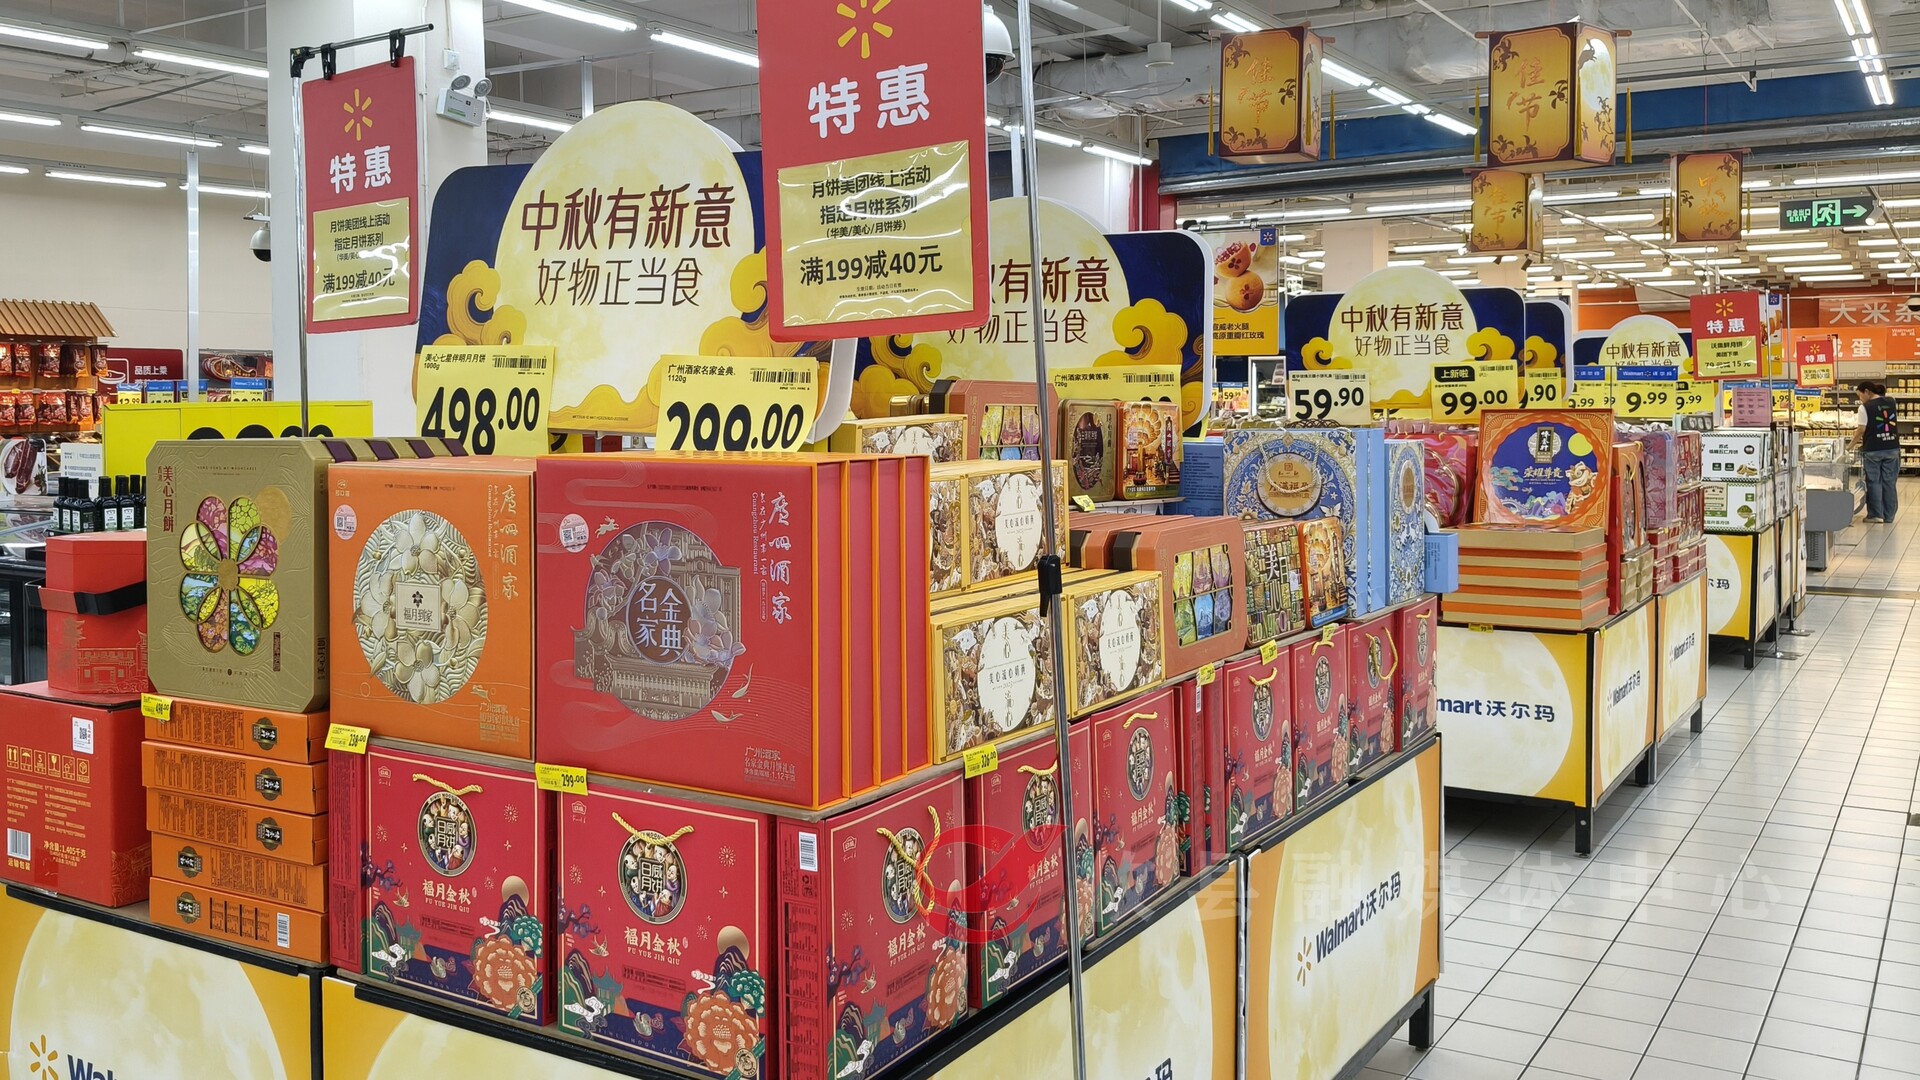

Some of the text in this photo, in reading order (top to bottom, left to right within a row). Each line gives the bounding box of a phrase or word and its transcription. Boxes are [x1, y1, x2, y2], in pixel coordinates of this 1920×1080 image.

[807, 62, 930, 139] 特惠
[1242, 57, 1276, 124] 佳节
[1510, 56, 1546, 130] 佳节
[330, 145, 391, 193] 特惠
[811, 164, 931, 199] 月饼美团线上活动
[521, 183, 735, 251] 中秋有新意
[820, 194, 918, 225] 指定月饼系列
[1789, 215, 1808, 223] EXIT
[330, 213, 391, 233] 月饼美团线上活动
[334, 232, 384, 251] 指定月饼系列
[800, 244, 943, 287] 满199减40元
[322, 268, 396, 293] 满199减40元
[534, 257, 703, 306] 好物正当食
[991, 256, 1111, 304] 有新意
[1341, 302, 1464, 334] 中秋有新意
[1706, 318, 1745, 334] 特惠
[1355, 334, 1452, 358] 好物正当食
[1606, 341, 1682, 360] 中秋有新意
[1805, 354, 1826, 363] 特惠
[668, 374, 687, 384] 1120g
[1440, 369, 1469, 379] 上新啦
[1294, 387, 1365, 420] 59.90
[1440, 389, 1508, 416] 99.00
[1626, 391, 1668, 413] 9.99
[421, 387, 540, 455] 498.00
[1523, 466, 1564, 480] 荣耀尊贵
[162, 465, 174, 533] 美心月餅
[1486, 699, 1556, 723] 沃尔玛
[561, 773, 585, 787] 299.00
[8, 857, 31, 872] 运输包装
[641, 862, 664, 878] 日威
[422, 879, 472, 905] 福月金秋
[641, 876, 664, 893] 月饼
[434, 899, 446, 907] YUE
[447, 902, 457, 911] JIN
[458, 905, 470, 914] QIU
[1315, 870, 1401, 966] Walmart 沃尔玛
[624, 926, 682, 956] 福月金秋
[887, 923, 926, 957] 福月金秋
[627, 947, 680, 966] FU YUE JIN QIU
[630, 1037, 657, 1050] MOON
